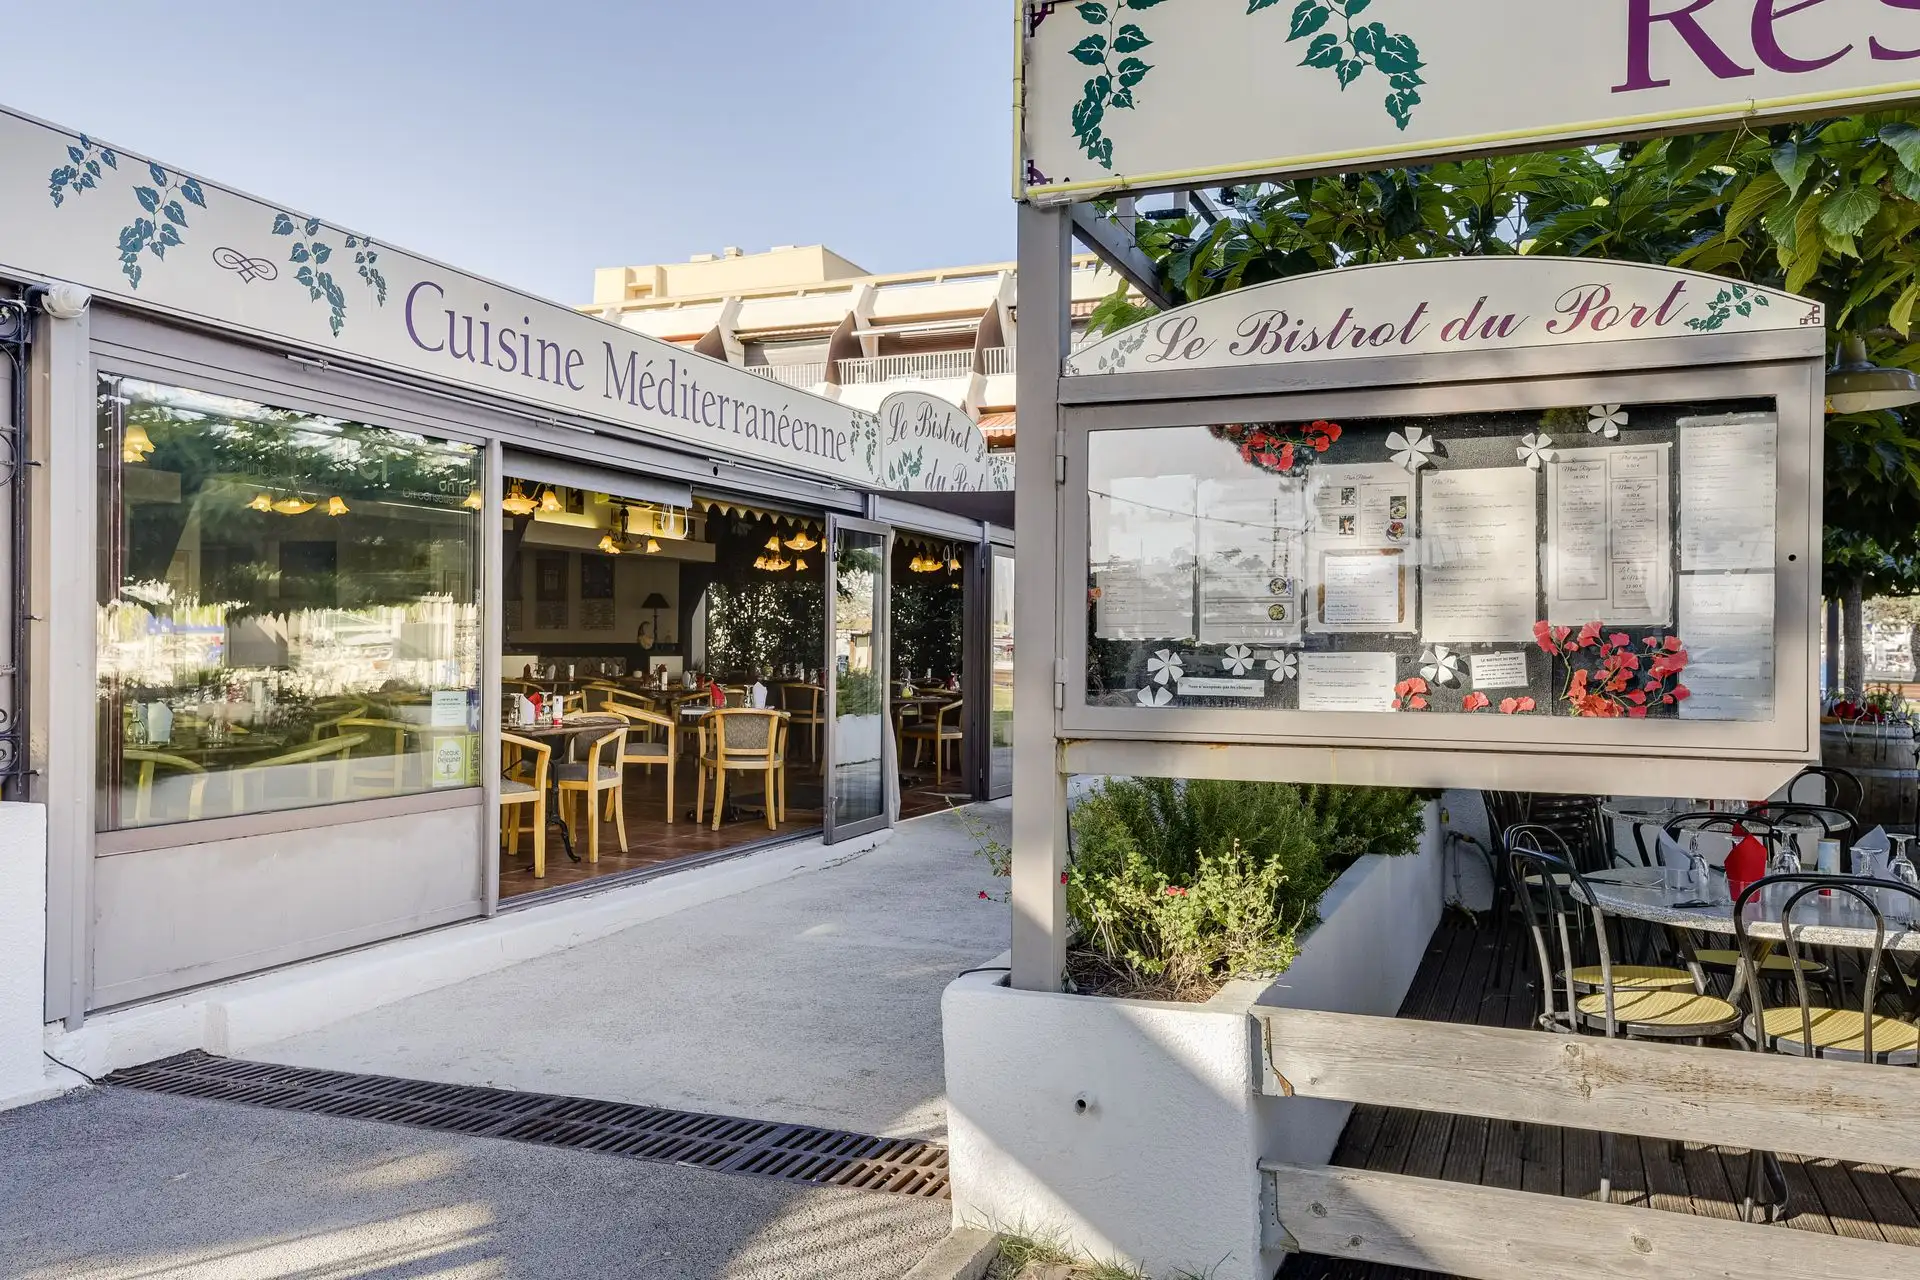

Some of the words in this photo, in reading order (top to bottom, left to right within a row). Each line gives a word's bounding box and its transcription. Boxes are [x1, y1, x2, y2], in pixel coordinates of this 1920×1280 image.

[1145, 315, 1217, 363] Le
[1228, 301, 1430, 356] Bistrot
[1440, 295, 1530, 342] du
[1546, 279, 1689, 335] Port
[405, 280, 585, 391] Cuisine
[602, 340, 847, 463] Méditerranéenne
[886, 401, 908, 446] Le
[914, 400, 971, 453] Bistrot
[924, 458, 946, 492] du
